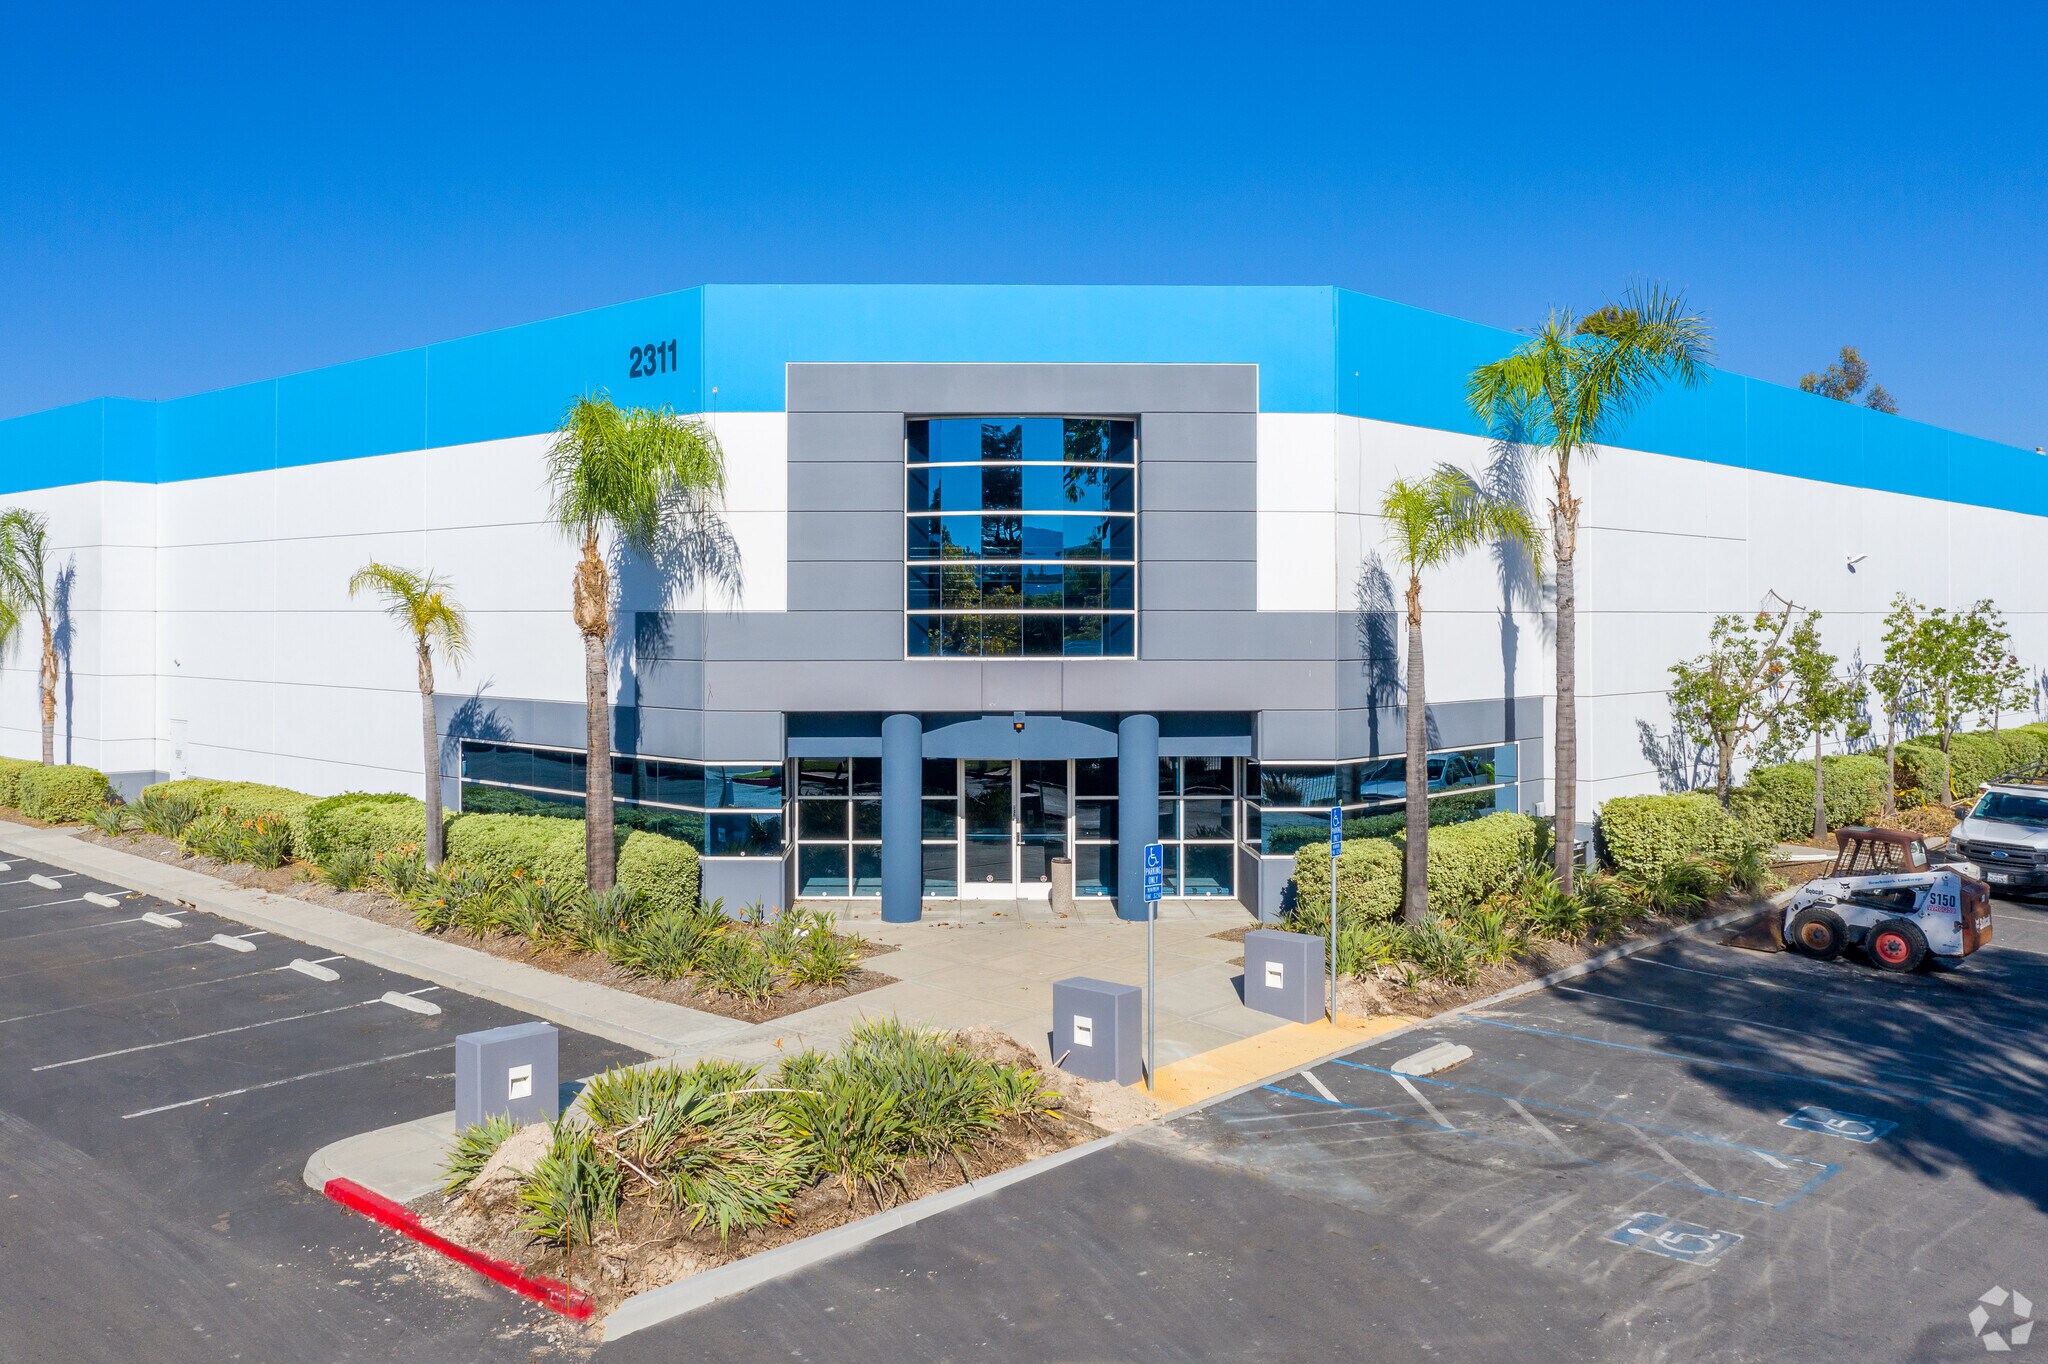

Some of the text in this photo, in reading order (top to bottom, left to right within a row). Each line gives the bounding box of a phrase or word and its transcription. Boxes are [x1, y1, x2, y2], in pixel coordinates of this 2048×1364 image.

[629, 338, 677, 379] 2311
[1145, 866, 1161, 876] PARKING
[1148, 876, 1158, 884] ONLY
[1805, 887, 1823, 896] Bobcat
[1930, 892, 1956, 907] S150
